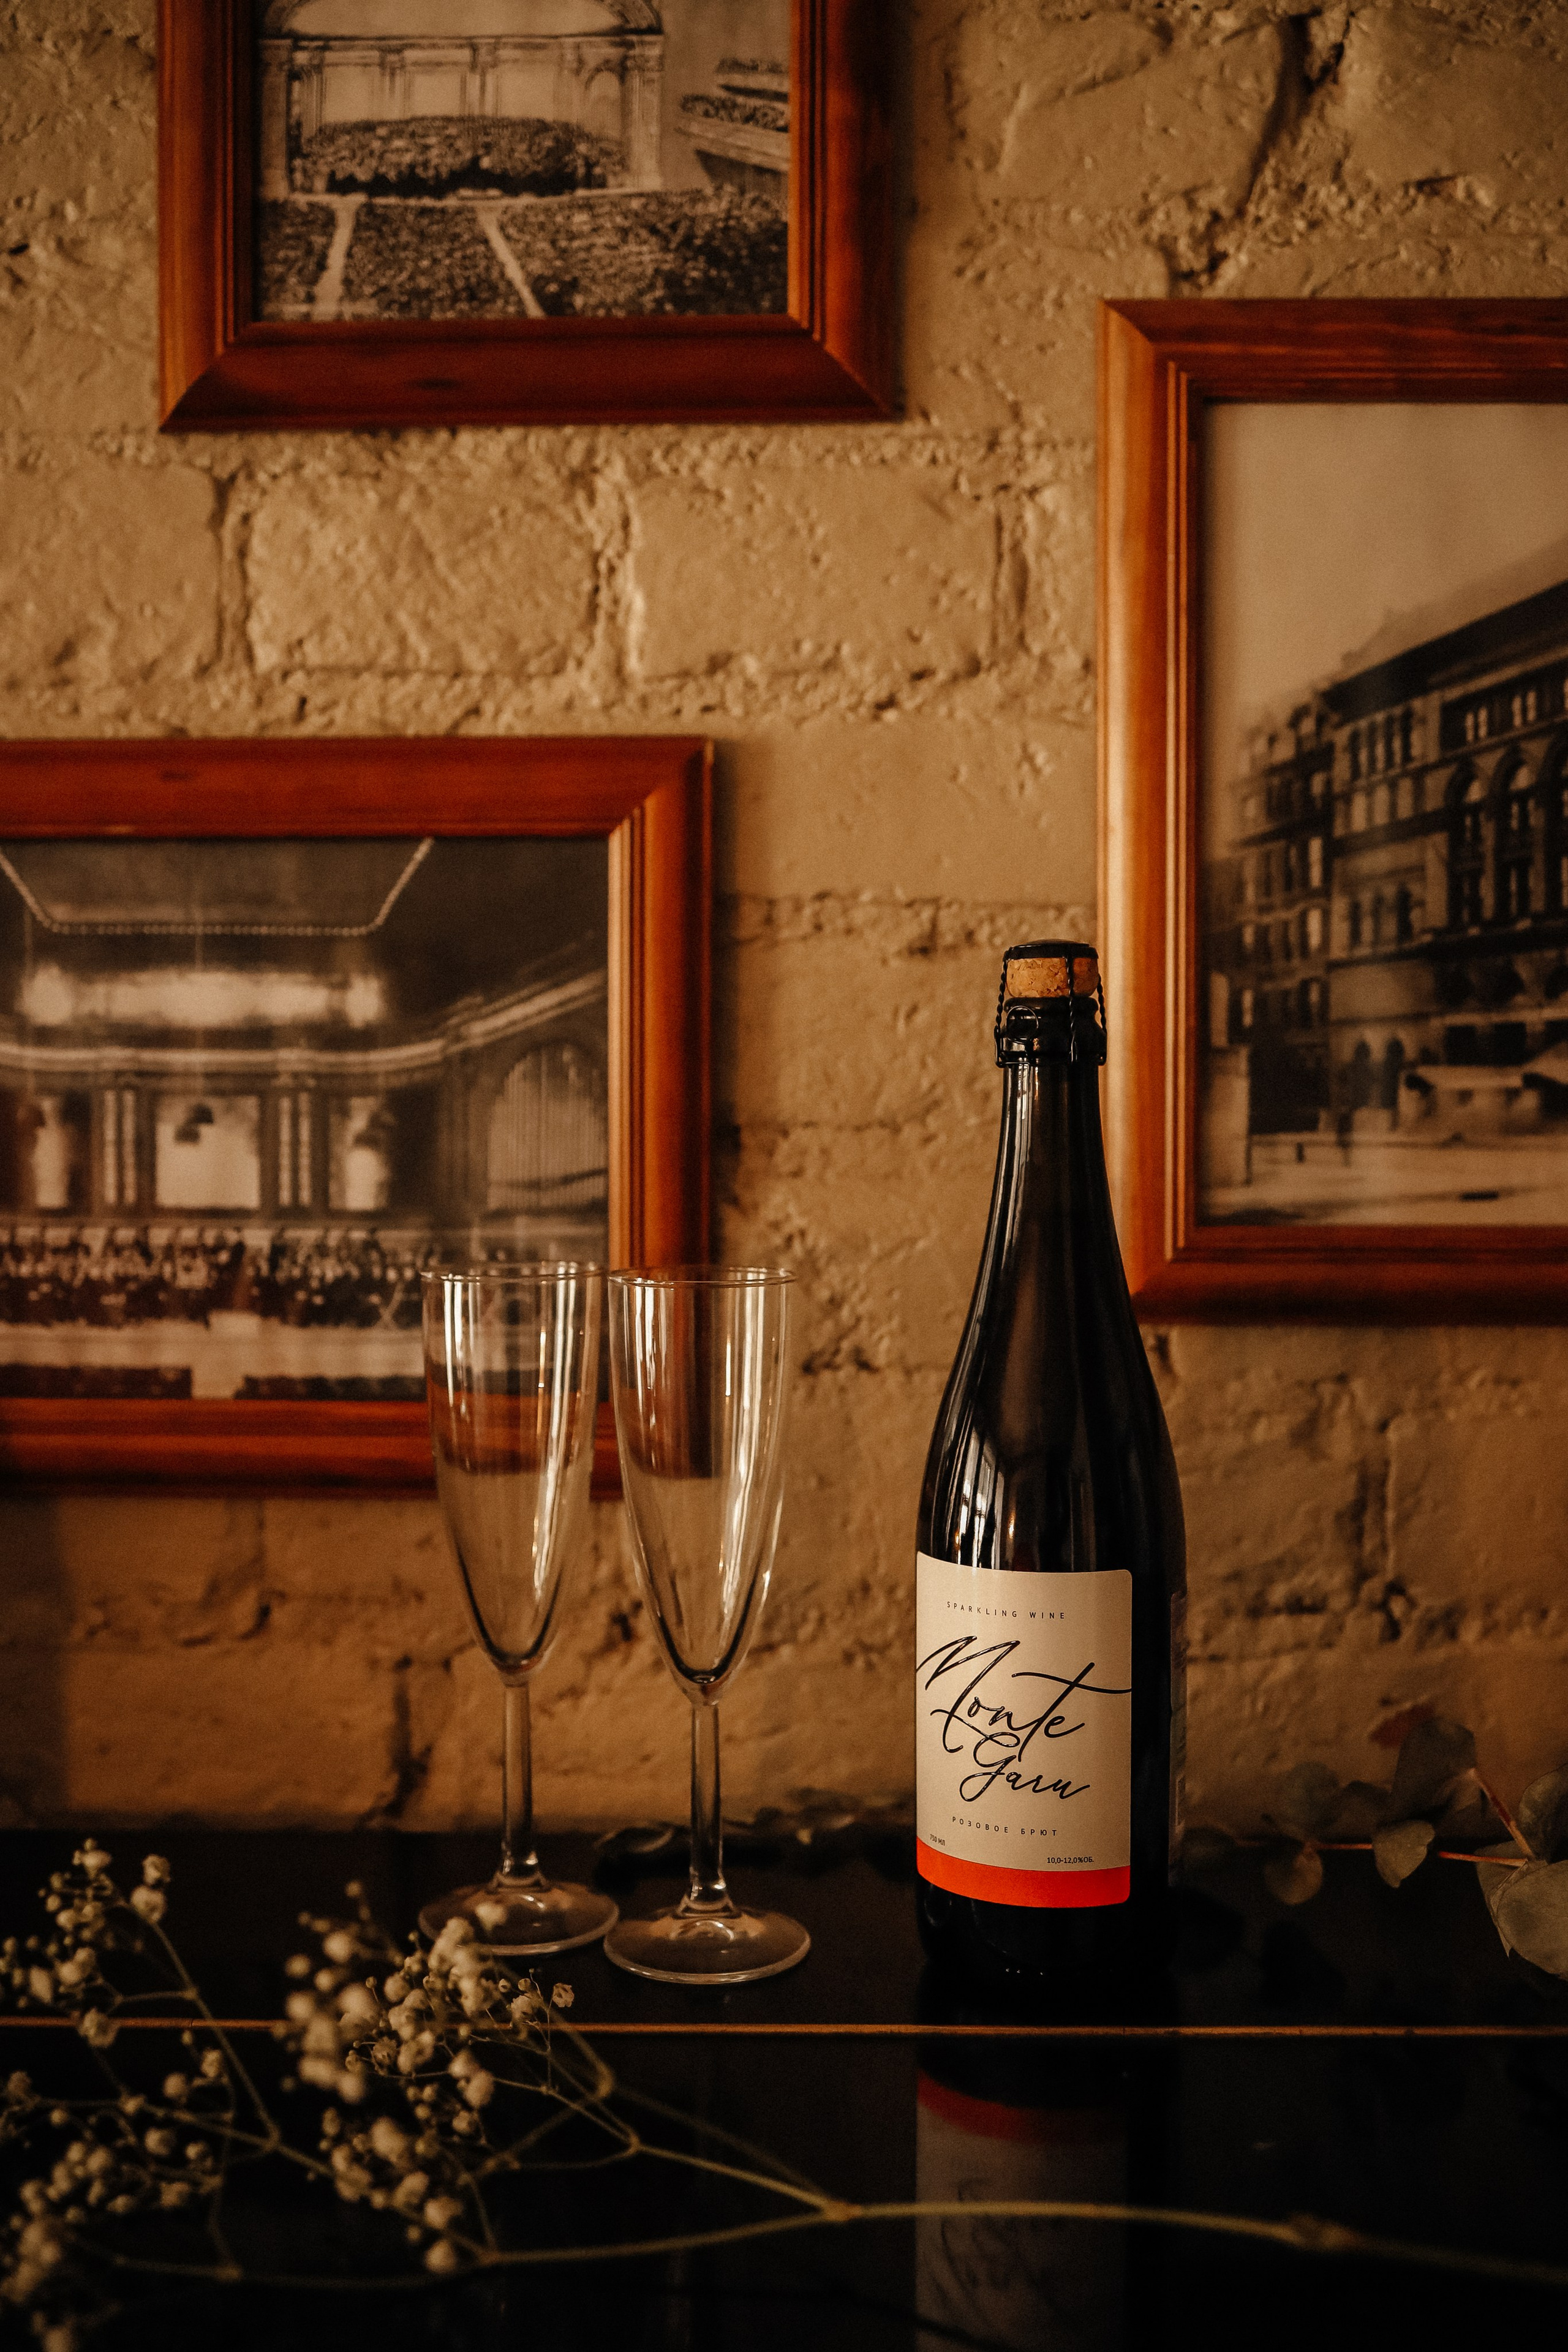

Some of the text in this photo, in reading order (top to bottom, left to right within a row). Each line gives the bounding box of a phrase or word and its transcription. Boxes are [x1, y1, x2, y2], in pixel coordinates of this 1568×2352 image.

[947, 1601, 1017, 1618] SPARKLING
[917, 1636, 1132, 1762] Monte
[952, 1816, 1008, 1833] РОЗОВОЕ
